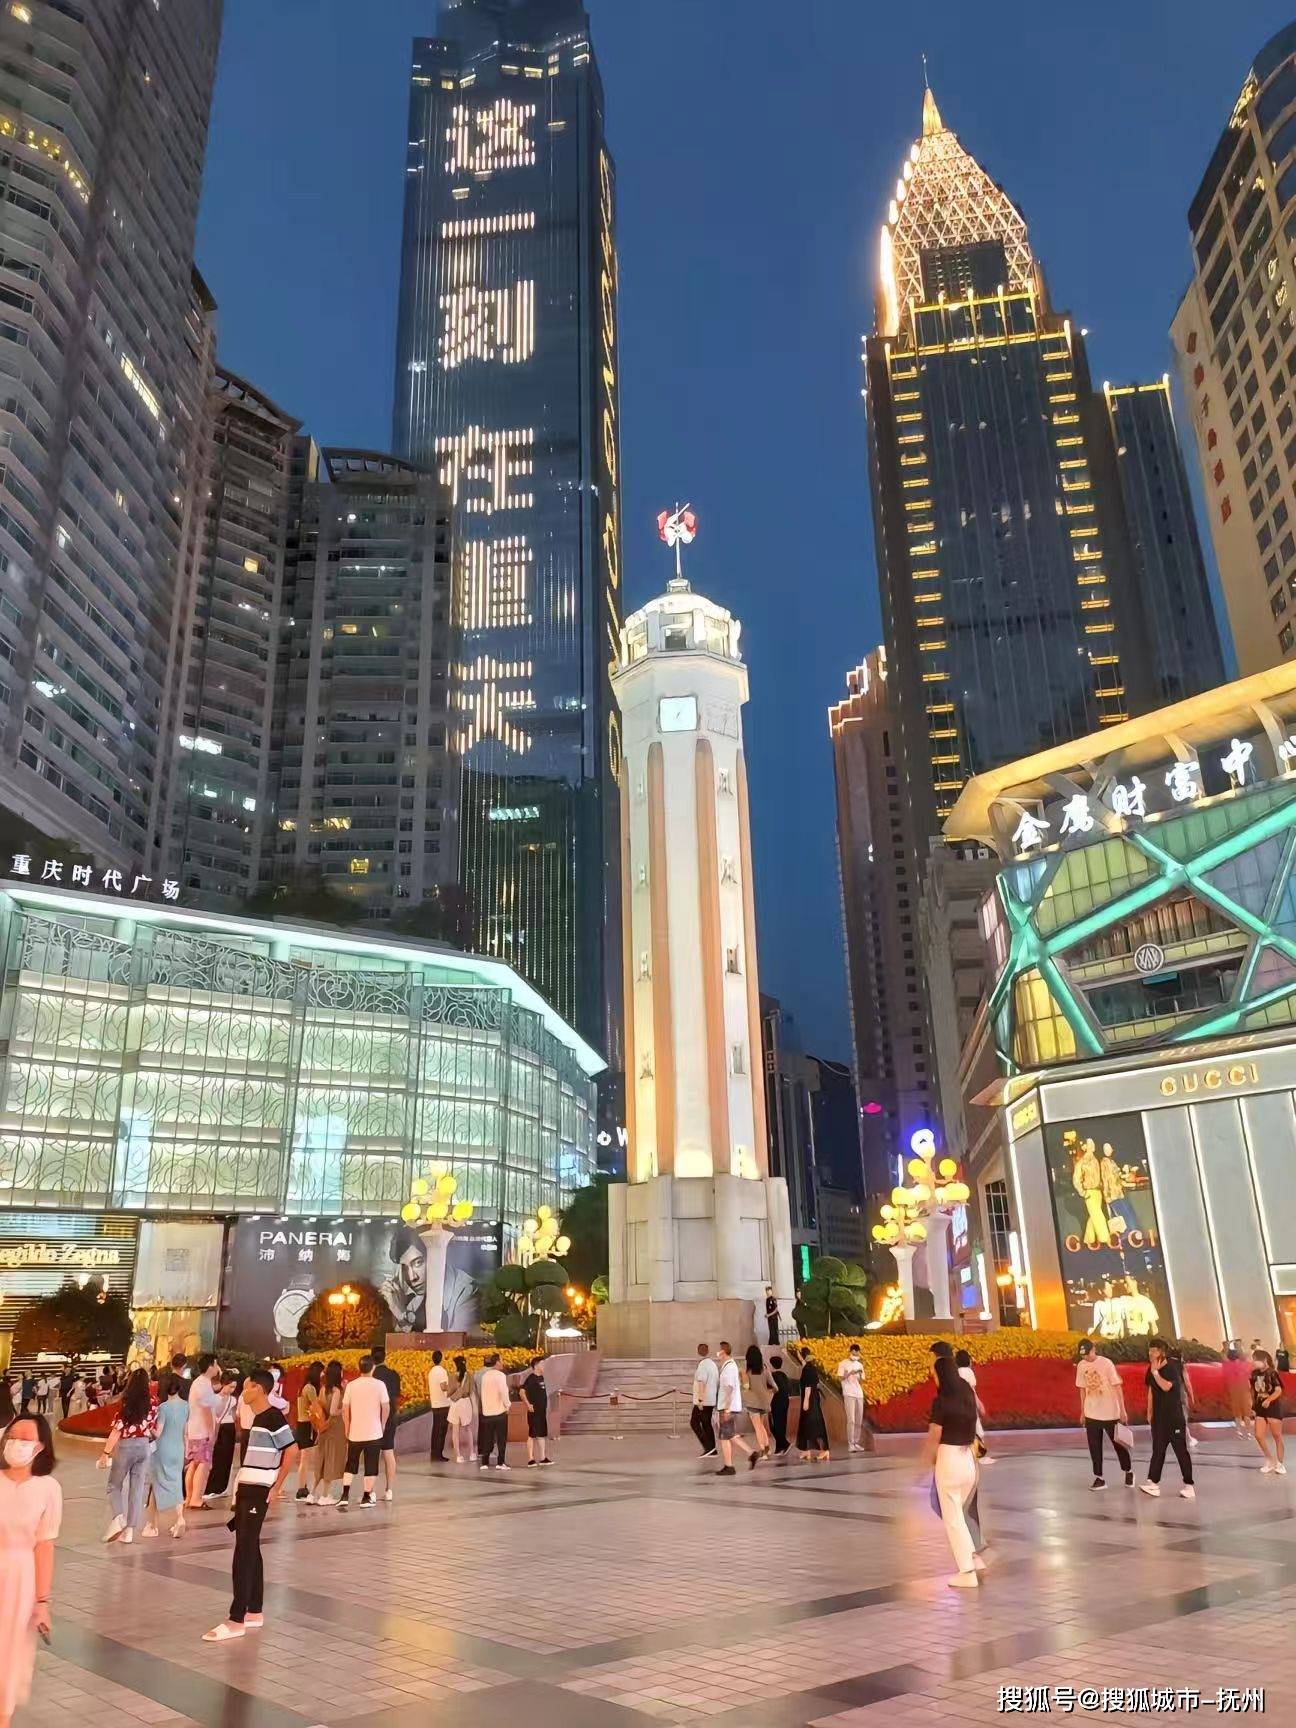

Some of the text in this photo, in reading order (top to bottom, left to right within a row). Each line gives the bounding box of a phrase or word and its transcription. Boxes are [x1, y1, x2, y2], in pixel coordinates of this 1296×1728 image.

[9, 853, 181, 900] 重庆时代广场
[1160, 1063, 1260, 1097] GUCCI
[259, 1231, 353, 1246] PANERAI
[61, 1243, 120, 1269] Zegna
[259, 1247, 351, 1262] 沛纳海
